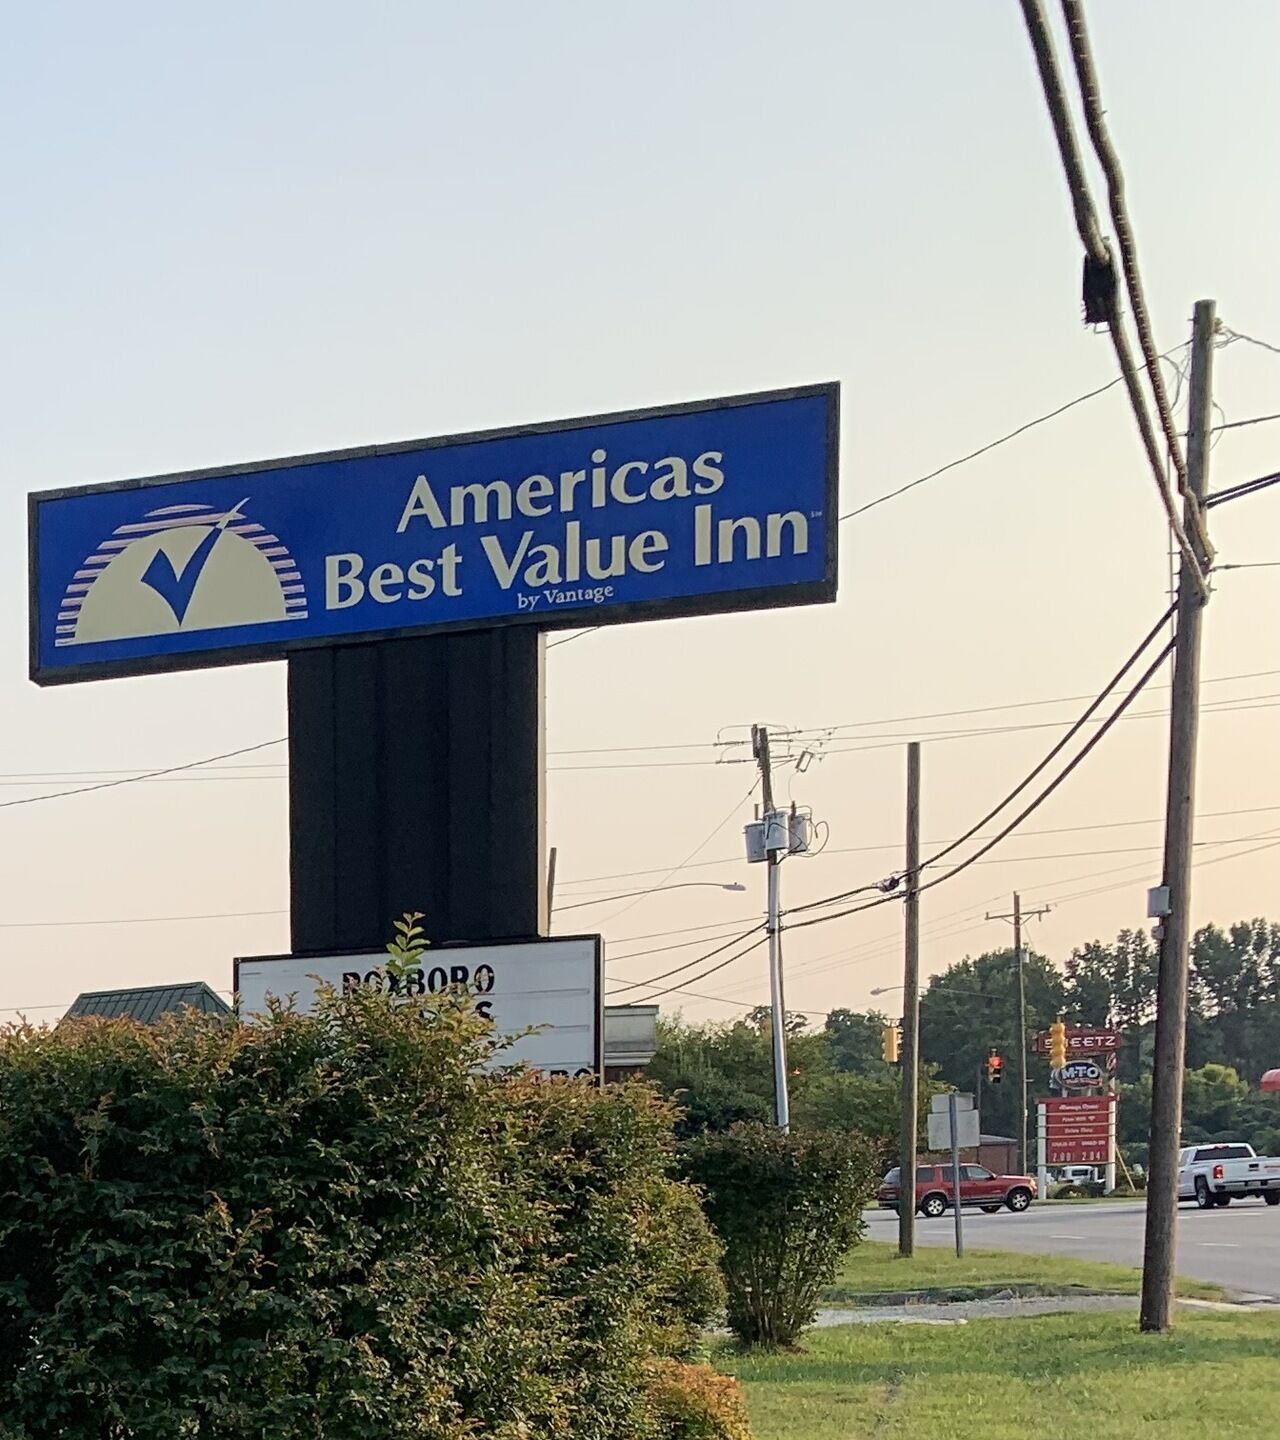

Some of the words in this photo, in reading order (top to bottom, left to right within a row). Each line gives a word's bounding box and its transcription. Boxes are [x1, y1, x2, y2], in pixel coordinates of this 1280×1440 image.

[396, 448, 725, 534] Americas
[325, 541, 463, 611] Best
[480, 520, 669, 591] Value
[694, 503, 809, 567] Inn
[517, 592, 540, 611] by
[543, 585, 615, 604] Vantage
[1044, 1036, 1116, 1048] SEETZ
